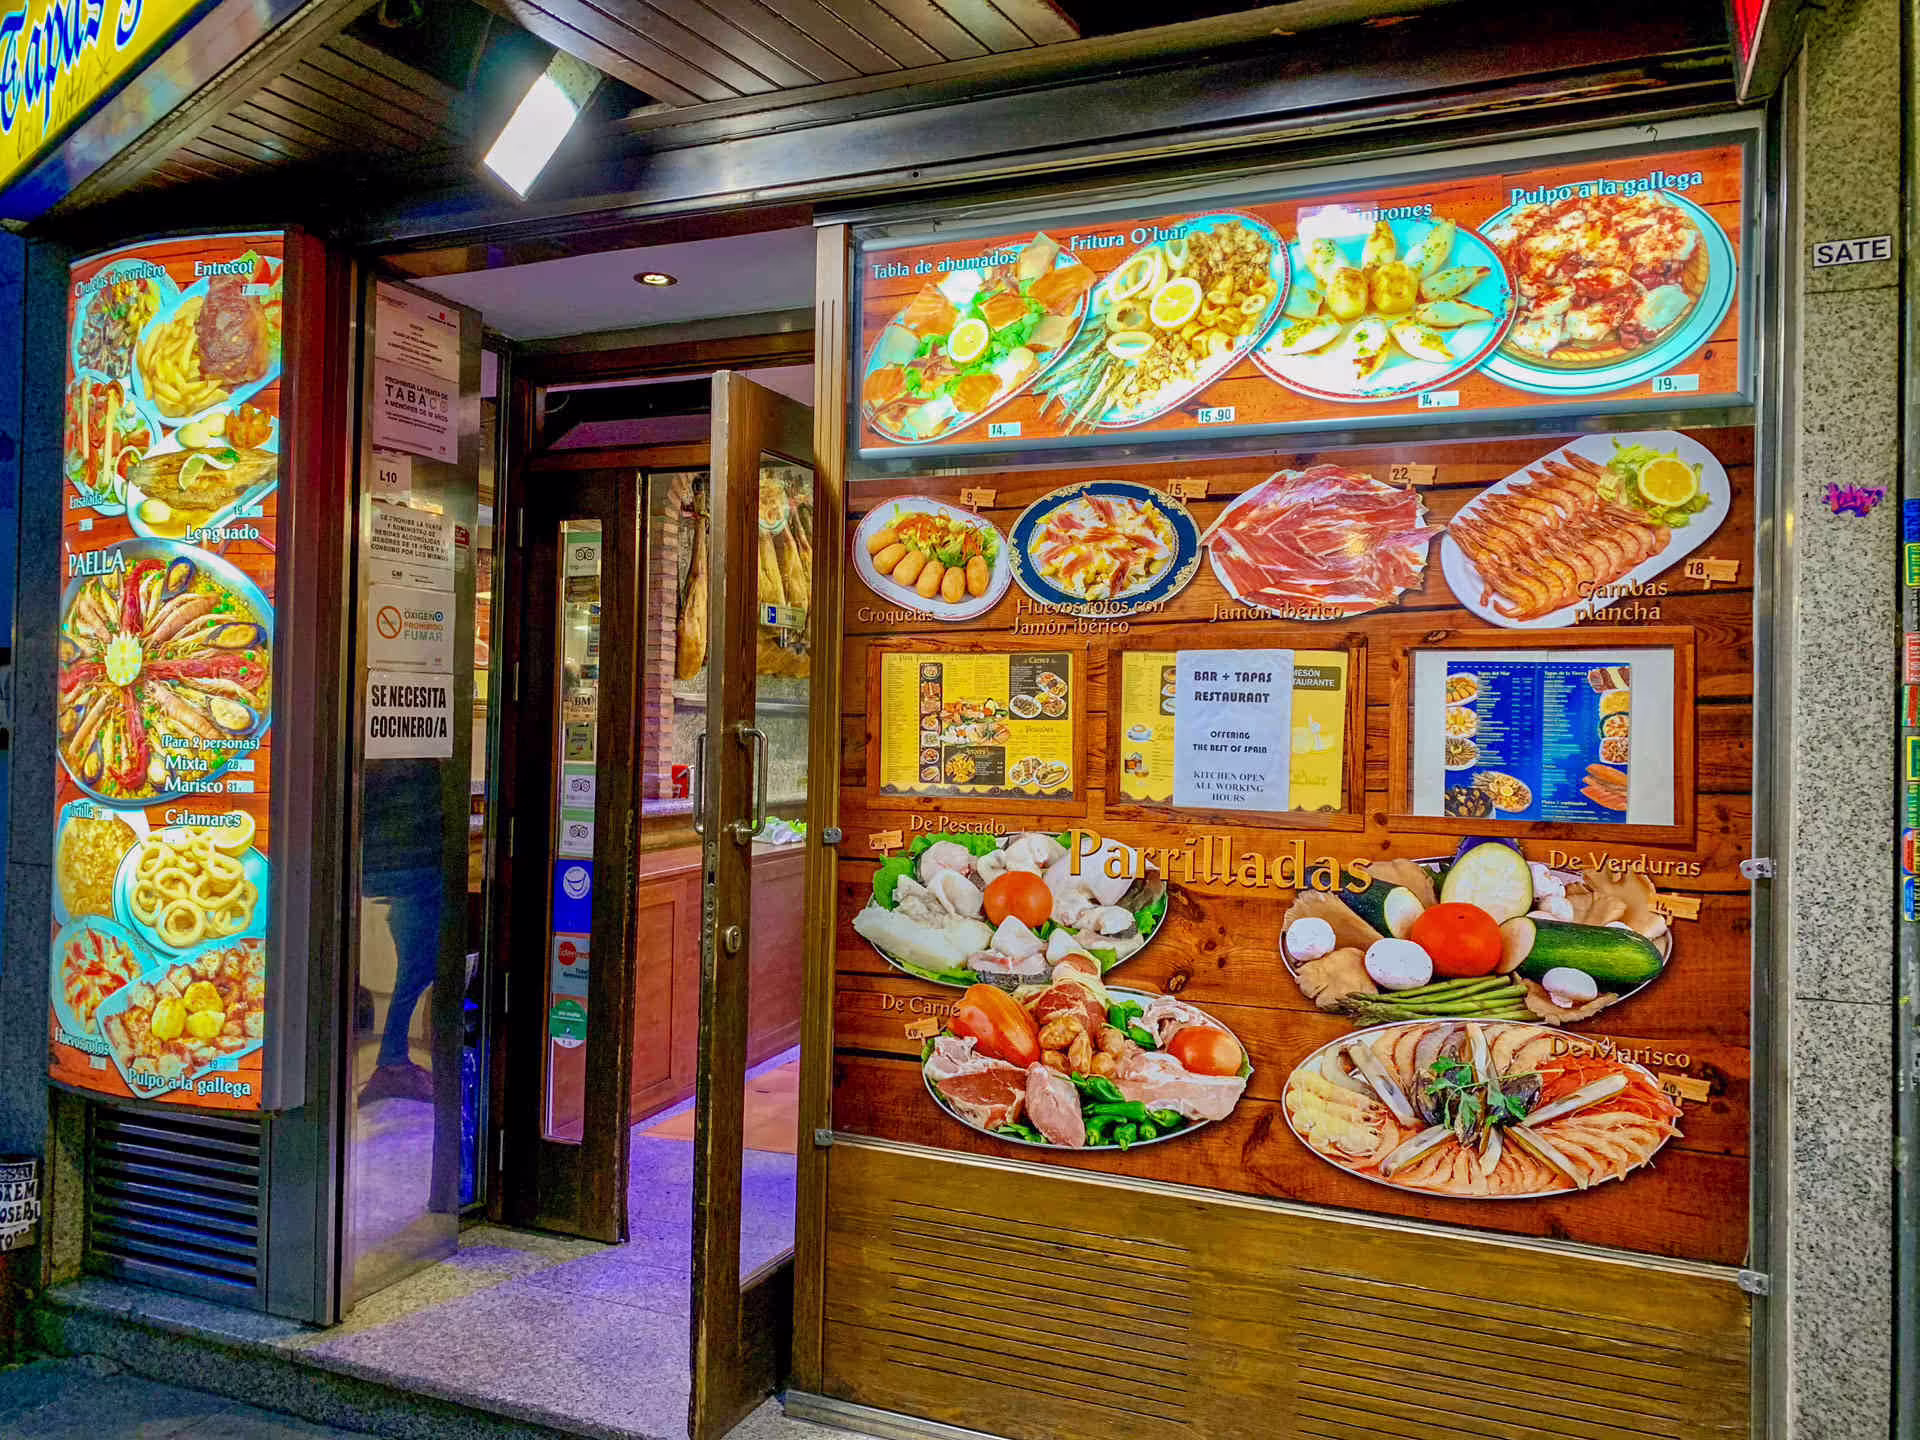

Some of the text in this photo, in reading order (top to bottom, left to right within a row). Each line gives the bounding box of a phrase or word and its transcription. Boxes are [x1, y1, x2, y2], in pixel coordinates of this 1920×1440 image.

[1511, 169, 1703, 207] Pulpo a la gallega
[1069, 234, 1125, 252] Fritura
[1818, 238, 1888, 264] SATE
[194, 259, 255, 278] Entrecot
[872, 251, 1018, 280] Tabla de ahumados
[384, 383, 448, 413] TABACO
[379, 469, 397, 484] L10
[185, 524, 260, 545] Lenguado
[68, 549, 125, 577] PAELLA
[1576, 578, 1669, 600] Gambas
[857, 607, 935, 625] Croquetas
[1016, 599, 1165, 616] Huevos rotos con
[1210, 602, 1344, 623] Jamón ibérico
[1574, 602, 1661, 624] plancha
[404, 630, 443, 642] FUMAR
[1010, 617, 1129, 635] Jamón ibérico
[1194, 671, 1217, 683] BAR
[1234, 671, 1272, 684] TAPAS
[371, 684, 447, 709] SE NECESITA
[1194, 691, 1270, 704] RESTAURANT
[370, 715, 447, 738] COCINERO/A
[1210, 730, 1251, 740] OFFERING
[1193, 743, 1268, 755] THE BEST OF SPAIN
[164, 755, 208, 771] Mixta
[164, 776, 224, 794] Marisco
[1193, 771, 1266, 783] KITCHEN OPEN
[1194, 782, 1264, 793] ALL WORKING
[1212, 791, 1246, 802] HOURS
[165, 808, 242, 827] Calamares
[911, 814, 1008, 835] De Pescado
[1065, 827, 1376, 894] Parrilladas
[1550, 850, 1702, 876] De Verduras
[881, 993, 961, 1018] De Carne
[1551, 1037, 1692, 1069] De Marisco
[127, 1067, 165, 1089] Pulpo
[169, 1077, 176, 1089] a
[197, 1077, 251, 1098] gallega
